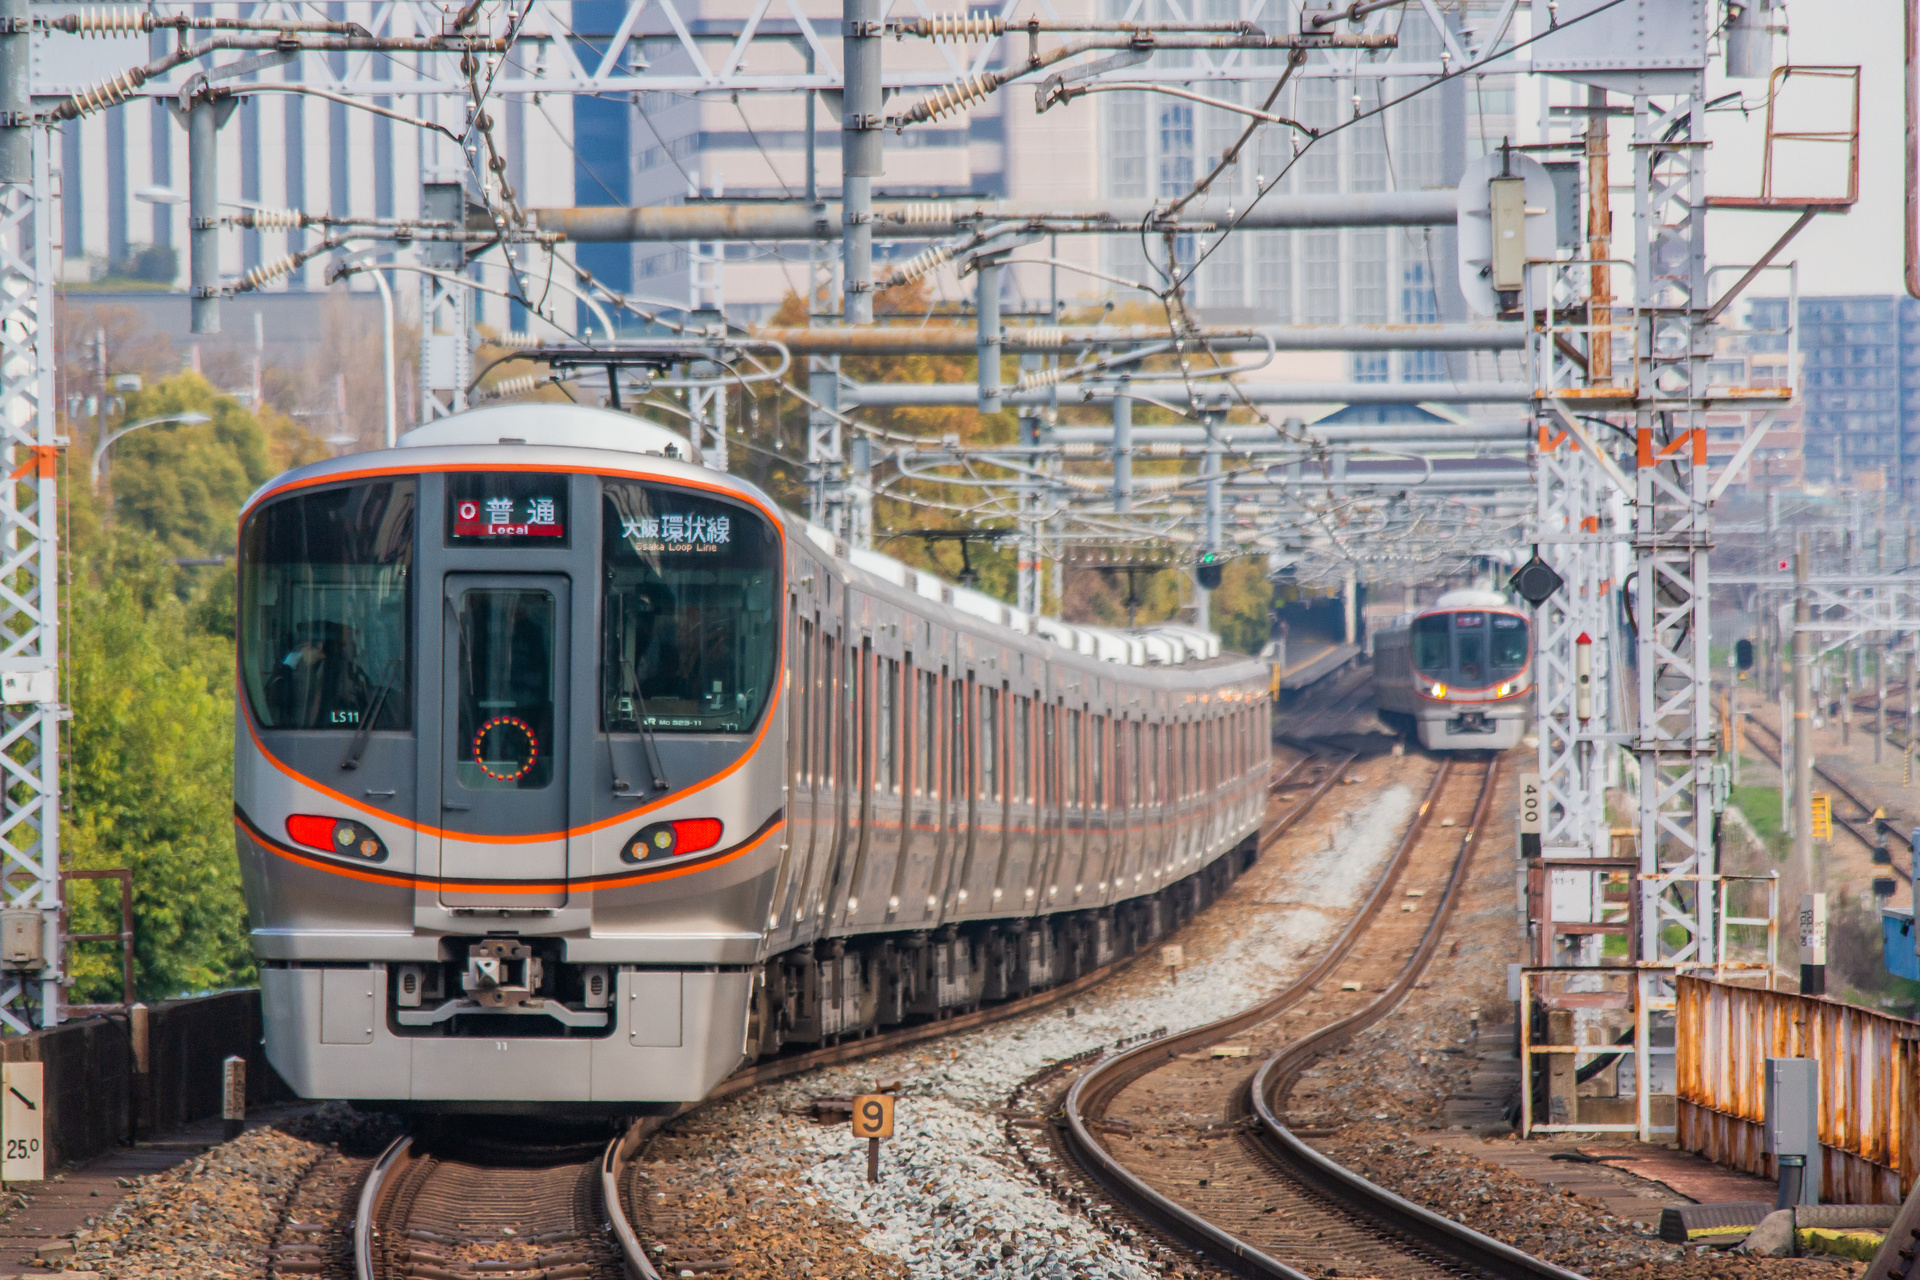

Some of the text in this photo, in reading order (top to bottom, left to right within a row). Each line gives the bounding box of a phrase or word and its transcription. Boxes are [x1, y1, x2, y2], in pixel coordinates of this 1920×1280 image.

[485, 498, 555, 525] 普通
[488, 524, 528, 535] Local
[622, 515, 730, 543] 大阪環状線
[669, 543, 693, 552] Loop
[697, 543, 717, 552] Line
[331, 711, 359, 722] LS11
[1524, 785, 1538, 822] 400
[496, 1041, 508, 1051] 11
[862, 1100, 884, 1133] 9
